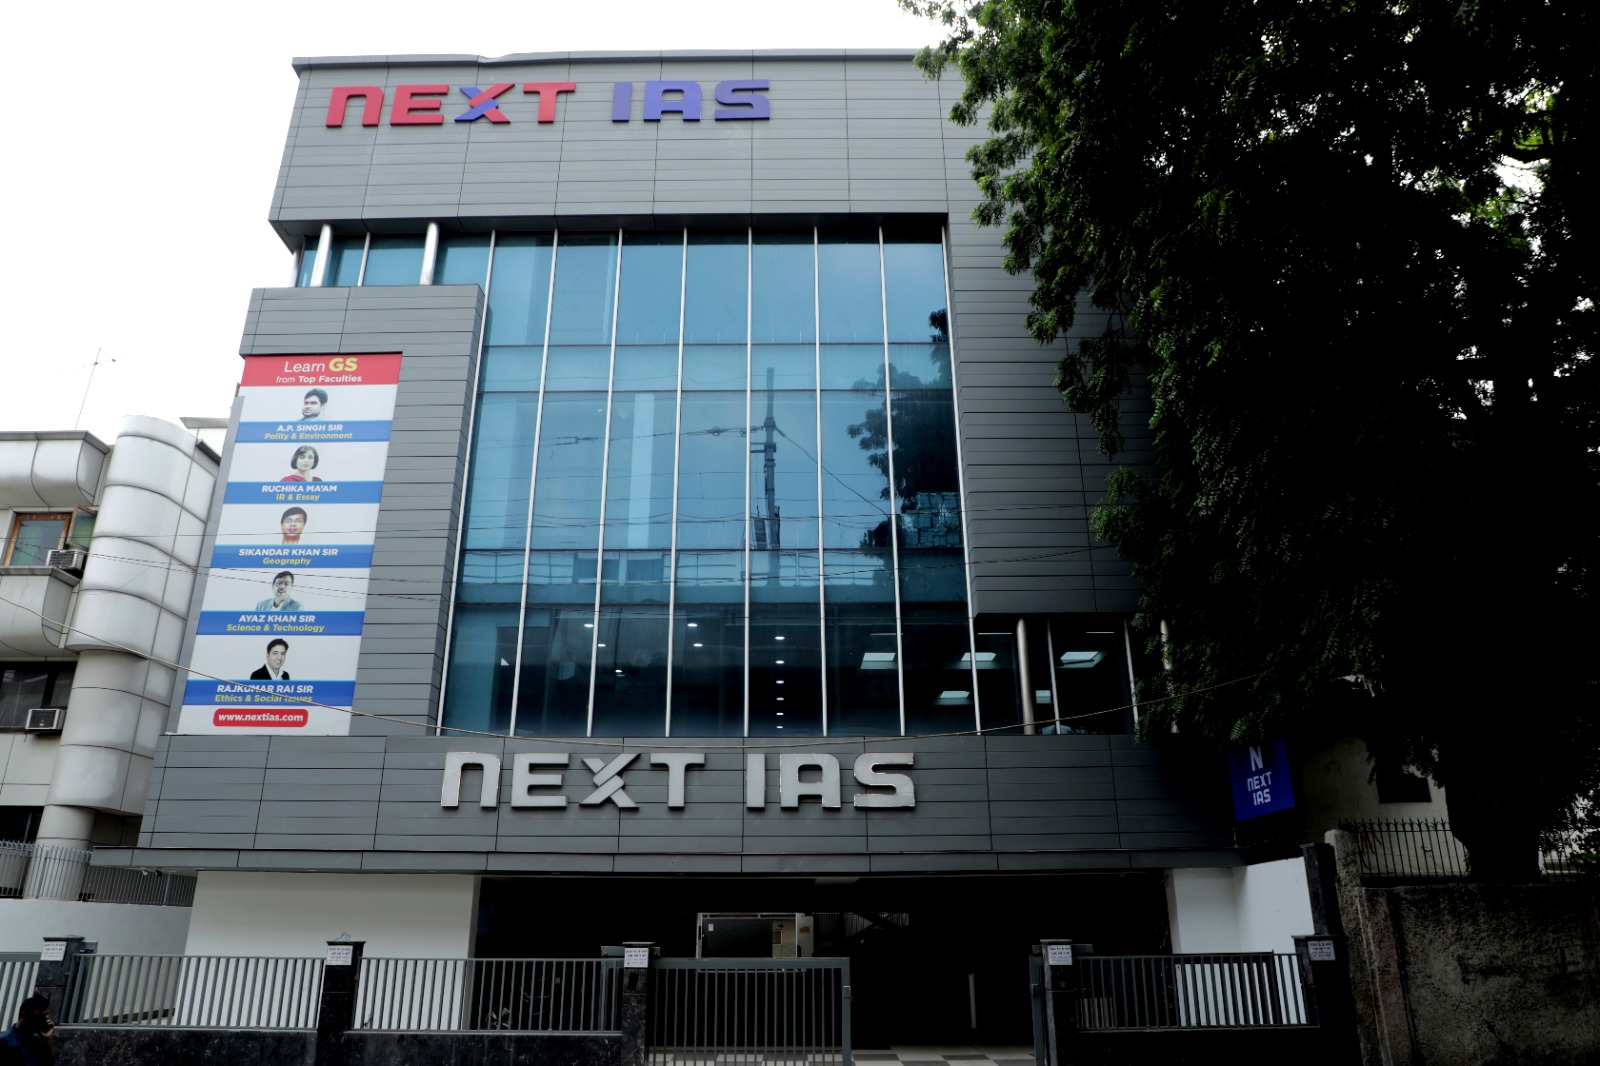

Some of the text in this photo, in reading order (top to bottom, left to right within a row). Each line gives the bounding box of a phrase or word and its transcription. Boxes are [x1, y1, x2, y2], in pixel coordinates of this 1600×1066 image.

[325, 79, 770, 127] NEXT IAS
[284, 357, 358, 373] Learn GS
[299, 375, 316, 384] Top
[319, 375, 362, 383] Faculties
[296, 424, 326, 432] SINGH
[264, 433, 289, 441] Polity
[299, 432, 353, 440] Environment
[262, 485, 304, 493] RUCHIKA
[296, 493, 320, 502] Essay
[291, 548, 320, 556] KHAN
[322, 548, 338, 556] SIR
[263, 557, 311, 566] Geography
[239, 614, 315, 622] AYAZ KHAN SIR
[226, 624, 261, 632] Science
[272, 623, 324, 633] Technology
[217, 685, 313, 693] RAJKUMAR RAI SIR
[214, 694, 242, 702] Ethics
[245, 694, 251, 702] &
[254, 694, 282, 702] Social
[218, 713, 304, 722] www.nextias.com
[440, 751, 916, 809] NEXT IAS
[1247, 771, 1272, 791] NEXT
[1252, 788, 1272, 806] IAS
